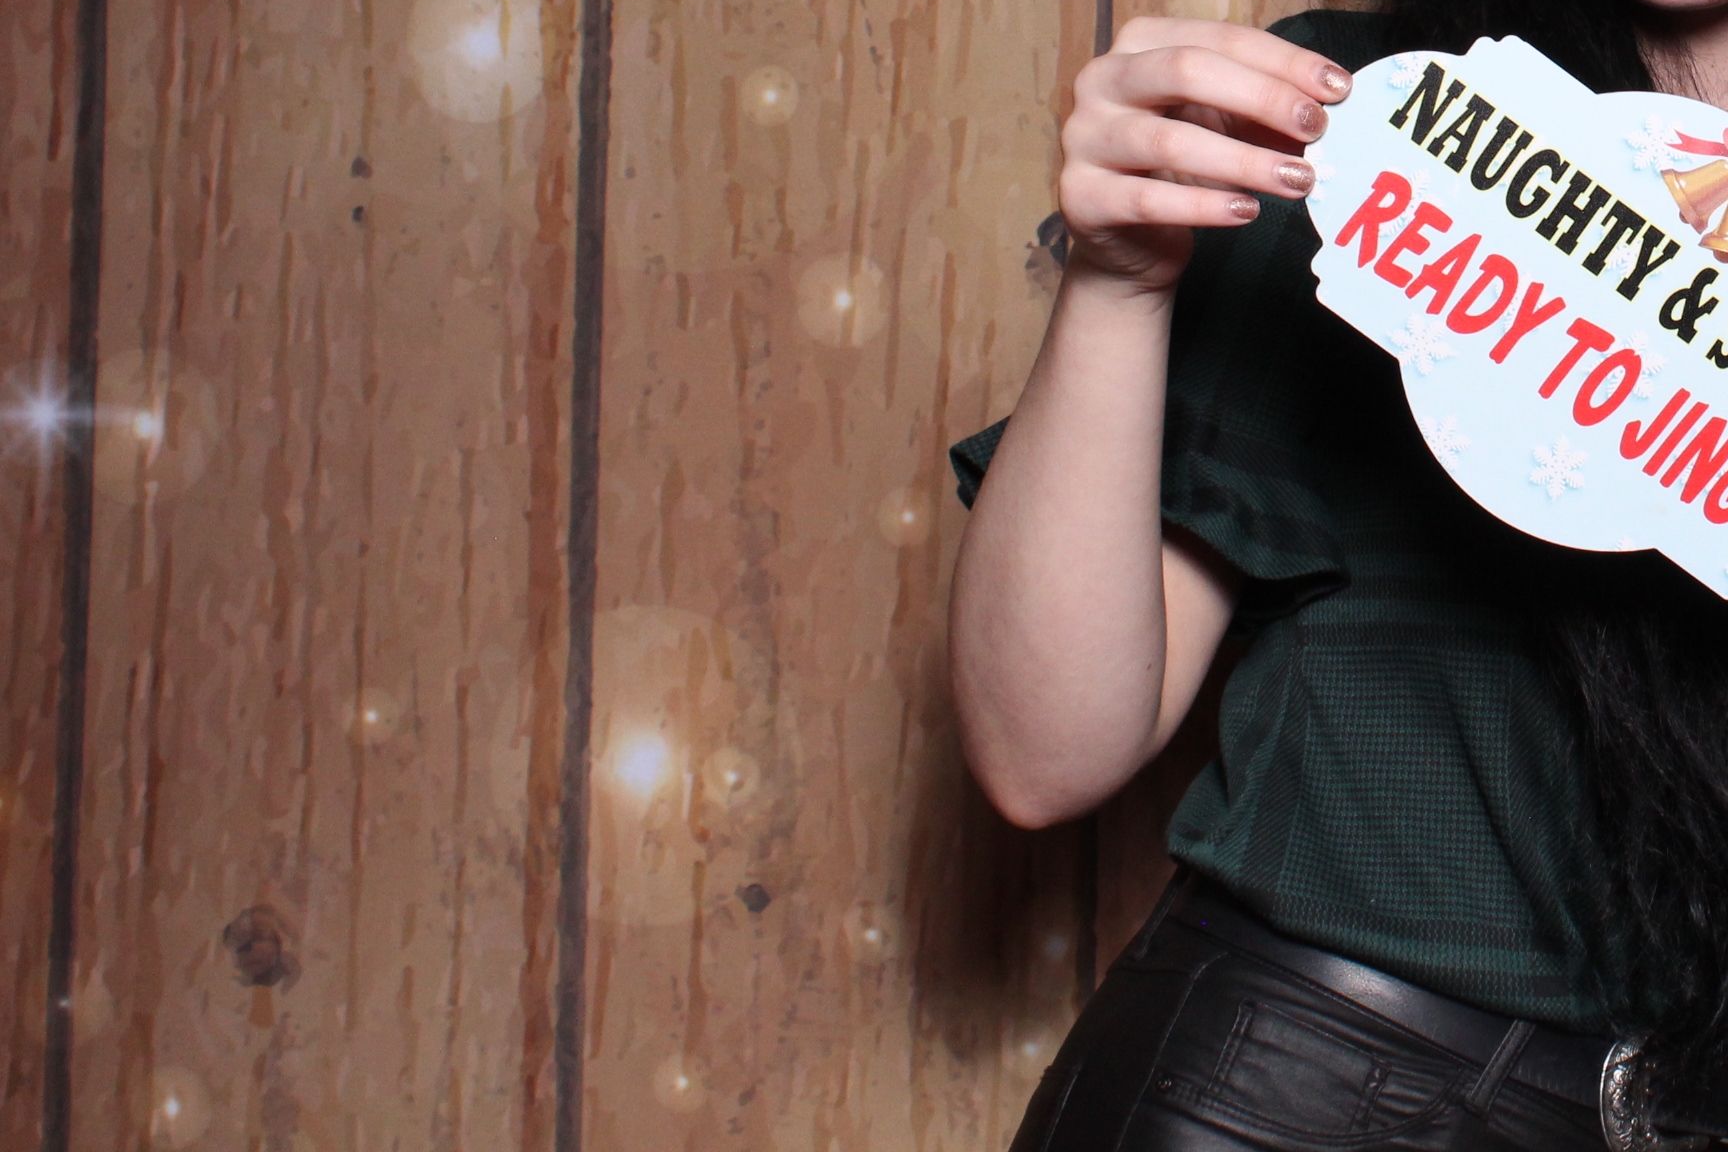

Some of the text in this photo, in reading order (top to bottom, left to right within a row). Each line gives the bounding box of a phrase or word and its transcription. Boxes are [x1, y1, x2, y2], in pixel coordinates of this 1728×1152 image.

[1335, 171, 1566, 365] READY
[1539, 317, 1643, 426] TO
[1389, 60, 1681, 302] NAUGHTY
[1658, 267, 1719, 344] &
